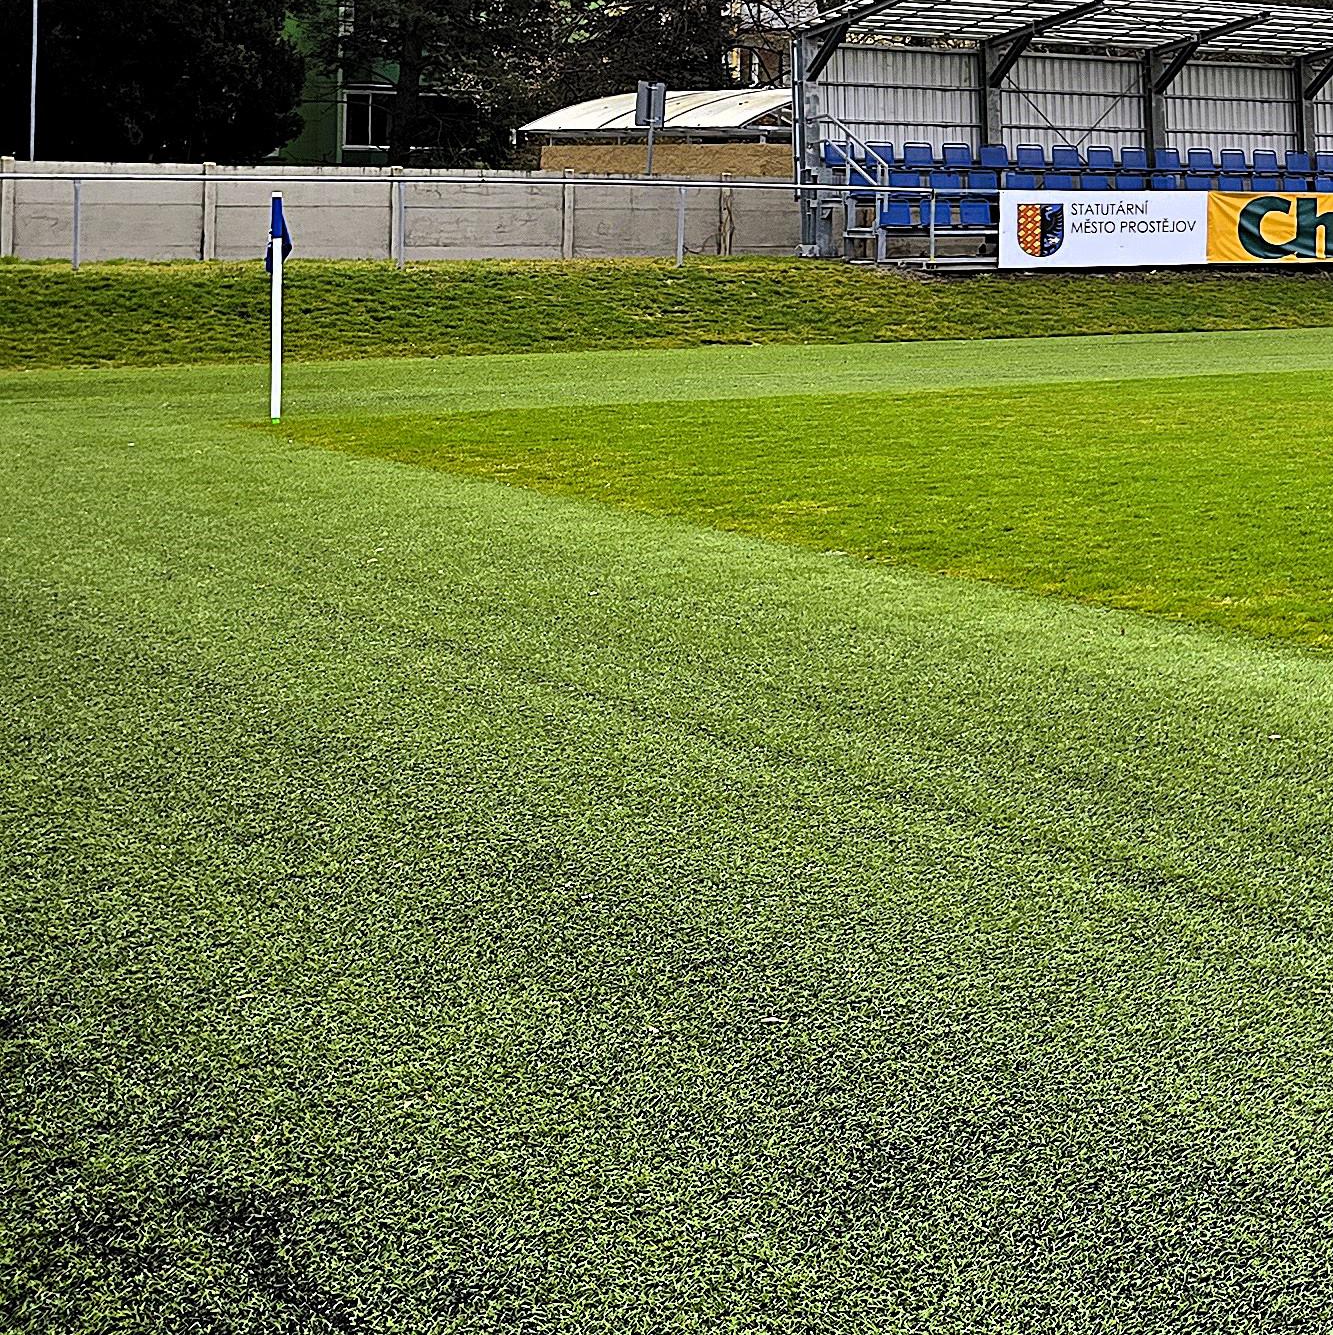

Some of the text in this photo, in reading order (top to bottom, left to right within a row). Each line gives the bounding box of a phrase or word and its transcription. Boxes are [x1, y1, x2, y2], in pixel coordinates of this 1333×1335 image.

[1070, 200, 1149, 216] STATUTÁRNÍ
[1070, 218, 1197, 234] MĚSTO PROSTĚJOV
